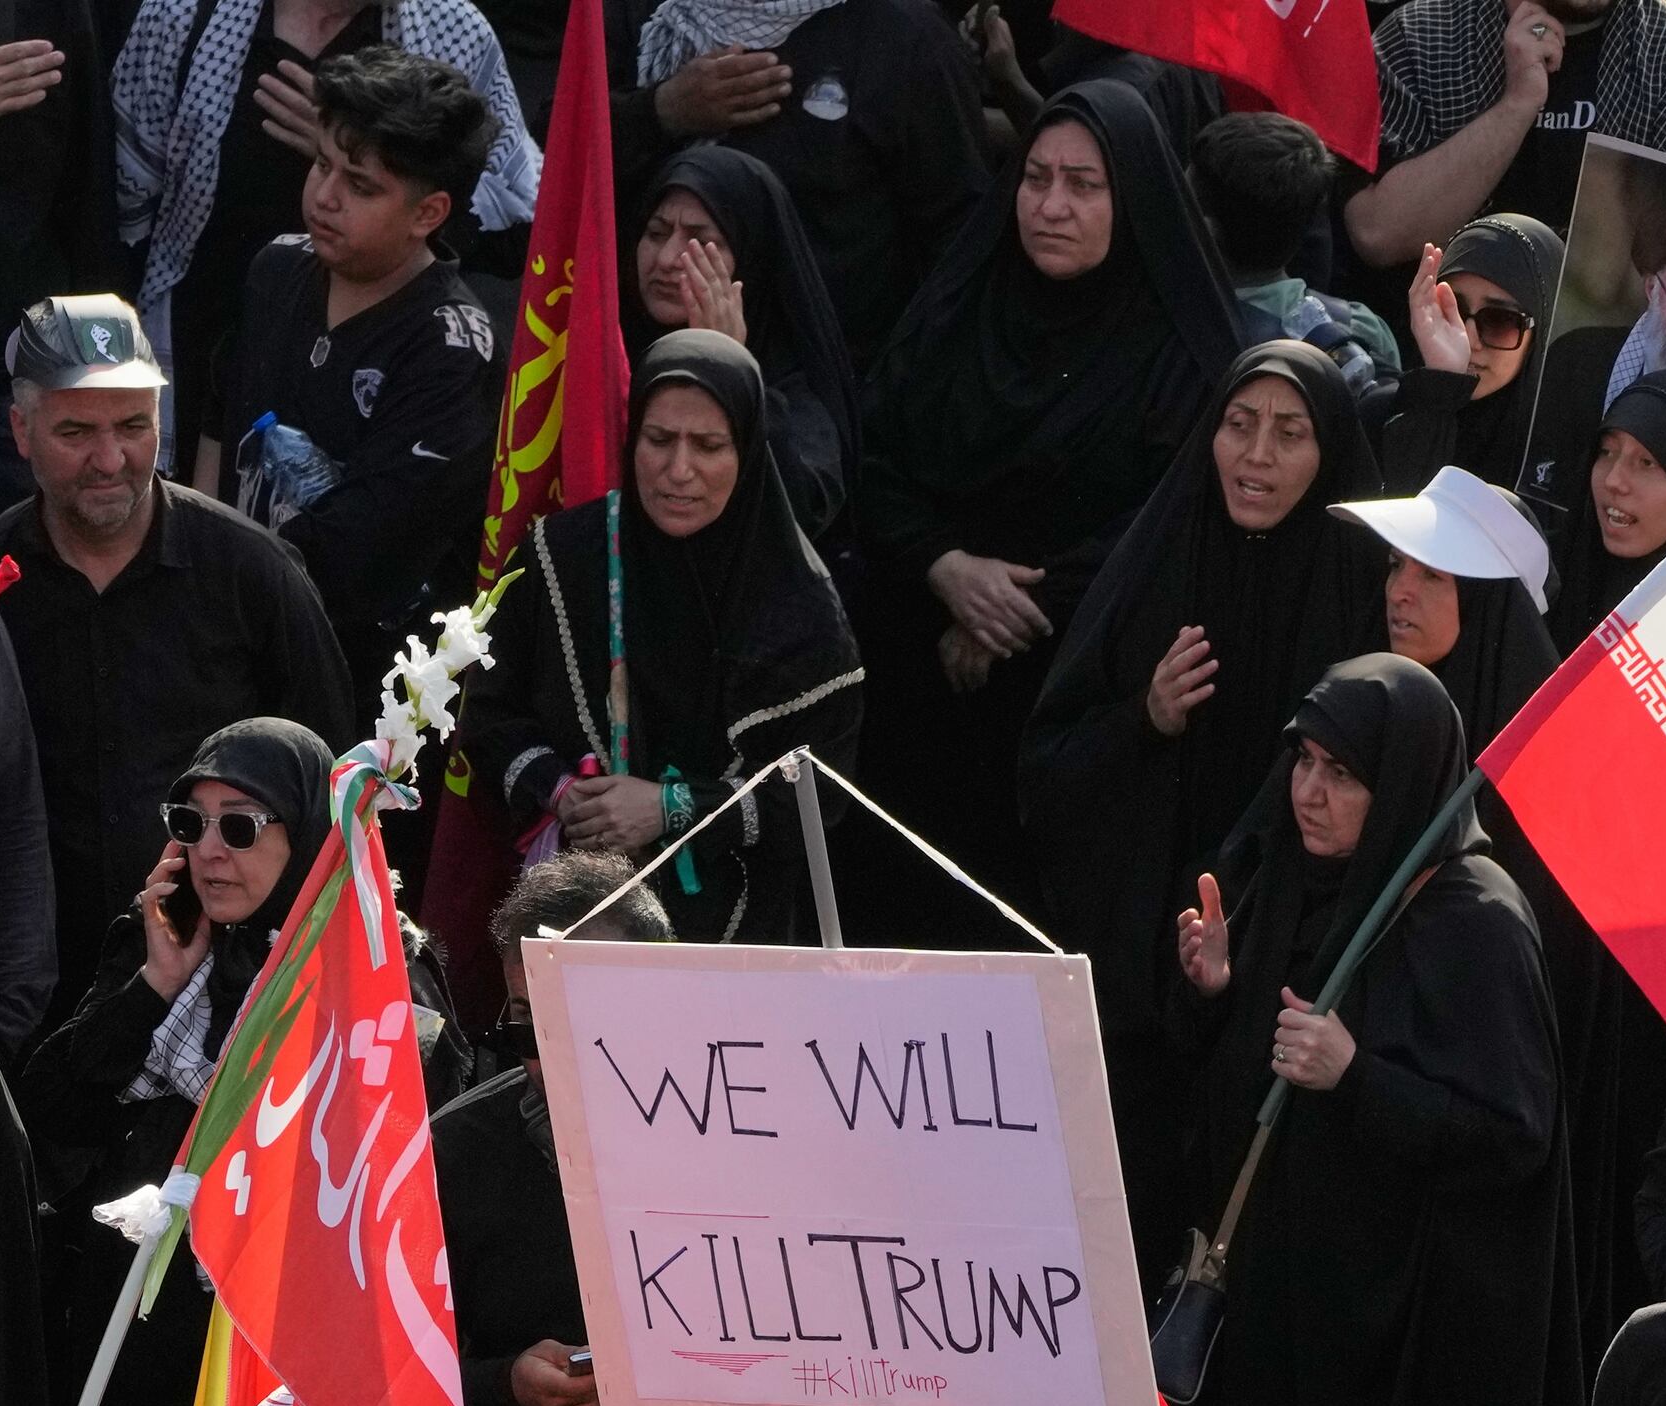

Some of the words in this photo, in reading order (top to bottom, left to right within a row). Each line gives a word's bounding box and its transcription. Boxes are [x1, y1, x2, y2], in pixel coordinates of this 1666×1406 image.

[434, 304, 494, 362] 15
[594, 1037, 778, 1138] WE
[805, 1029, 1038, 1132] WILL
